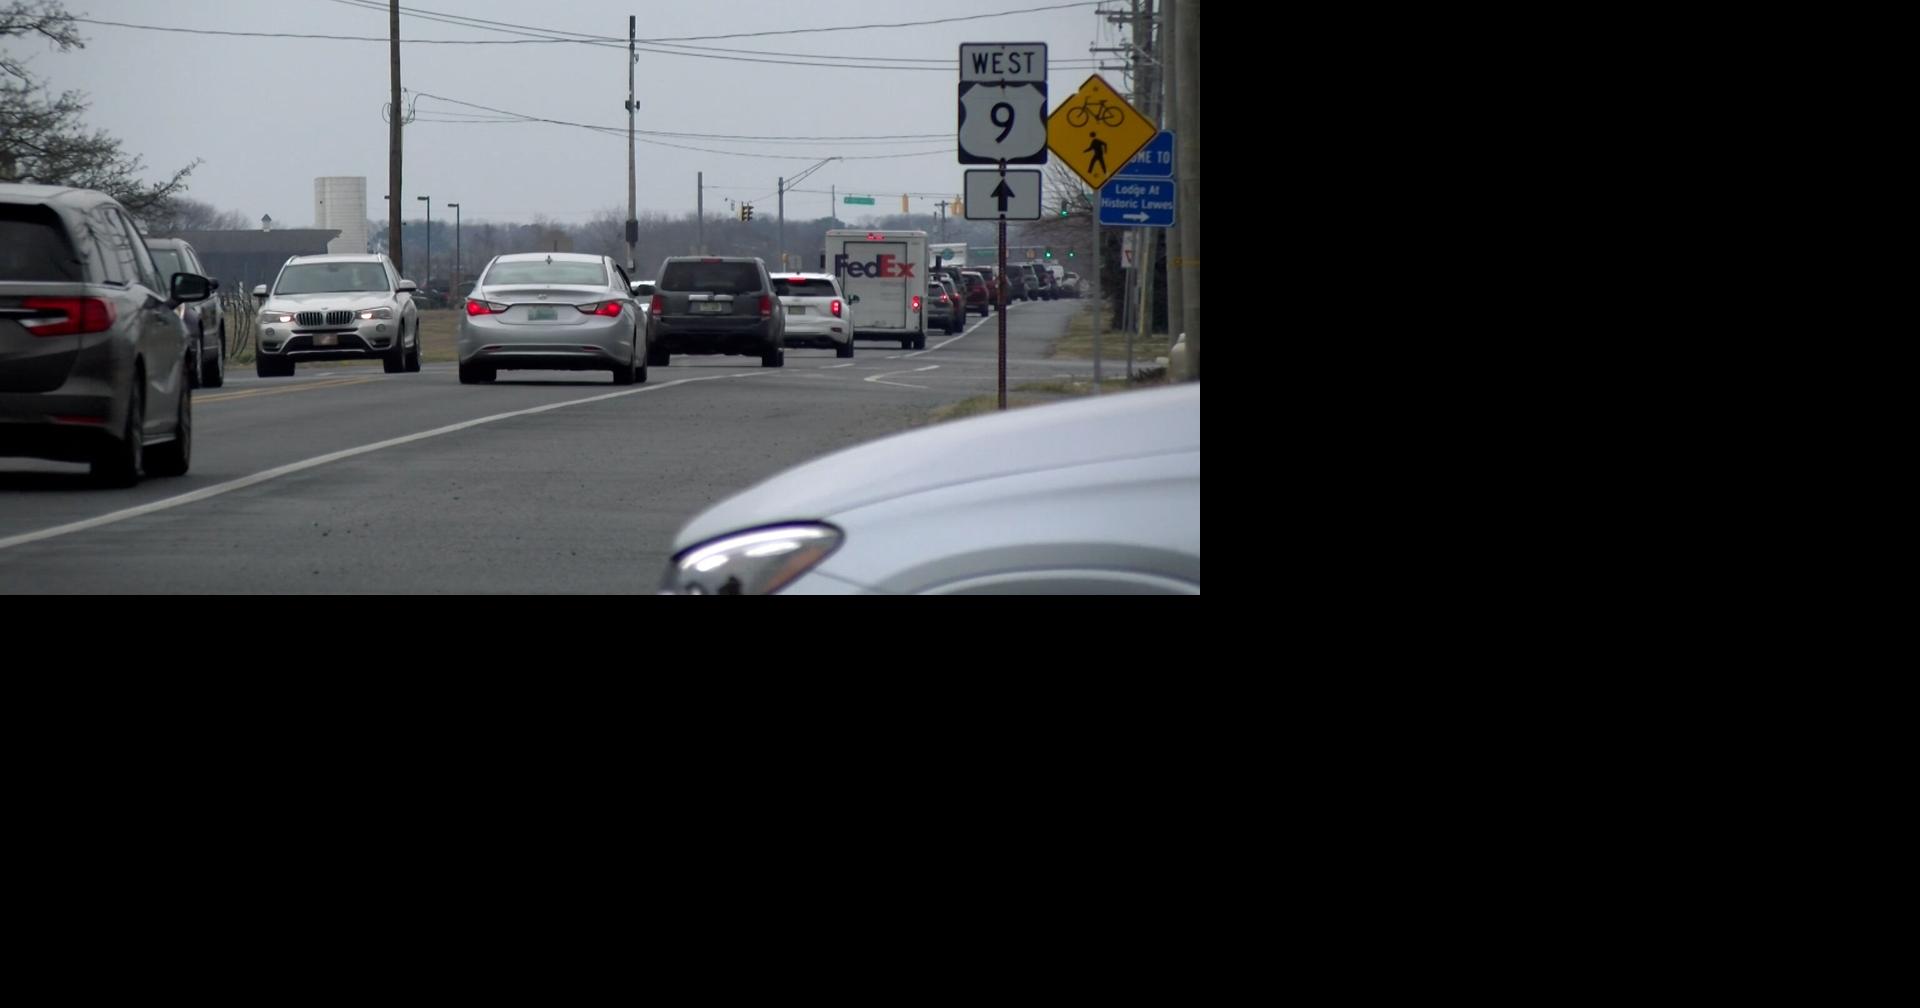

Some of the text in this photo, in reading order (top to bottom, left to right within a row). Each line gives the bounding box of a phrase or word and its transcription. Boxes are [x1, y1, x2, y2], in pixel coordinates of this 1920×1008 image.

[972, 52, 1035, 74] WEST
[990, 101, 1015, 144] 9
[1157, 151, 1170, 164] TO
[1115, 184, 1159, 197] Lodge At
[1102, 198, 1173, 210] Historic Lewes
[834, 253, 916, 278] FedEx
